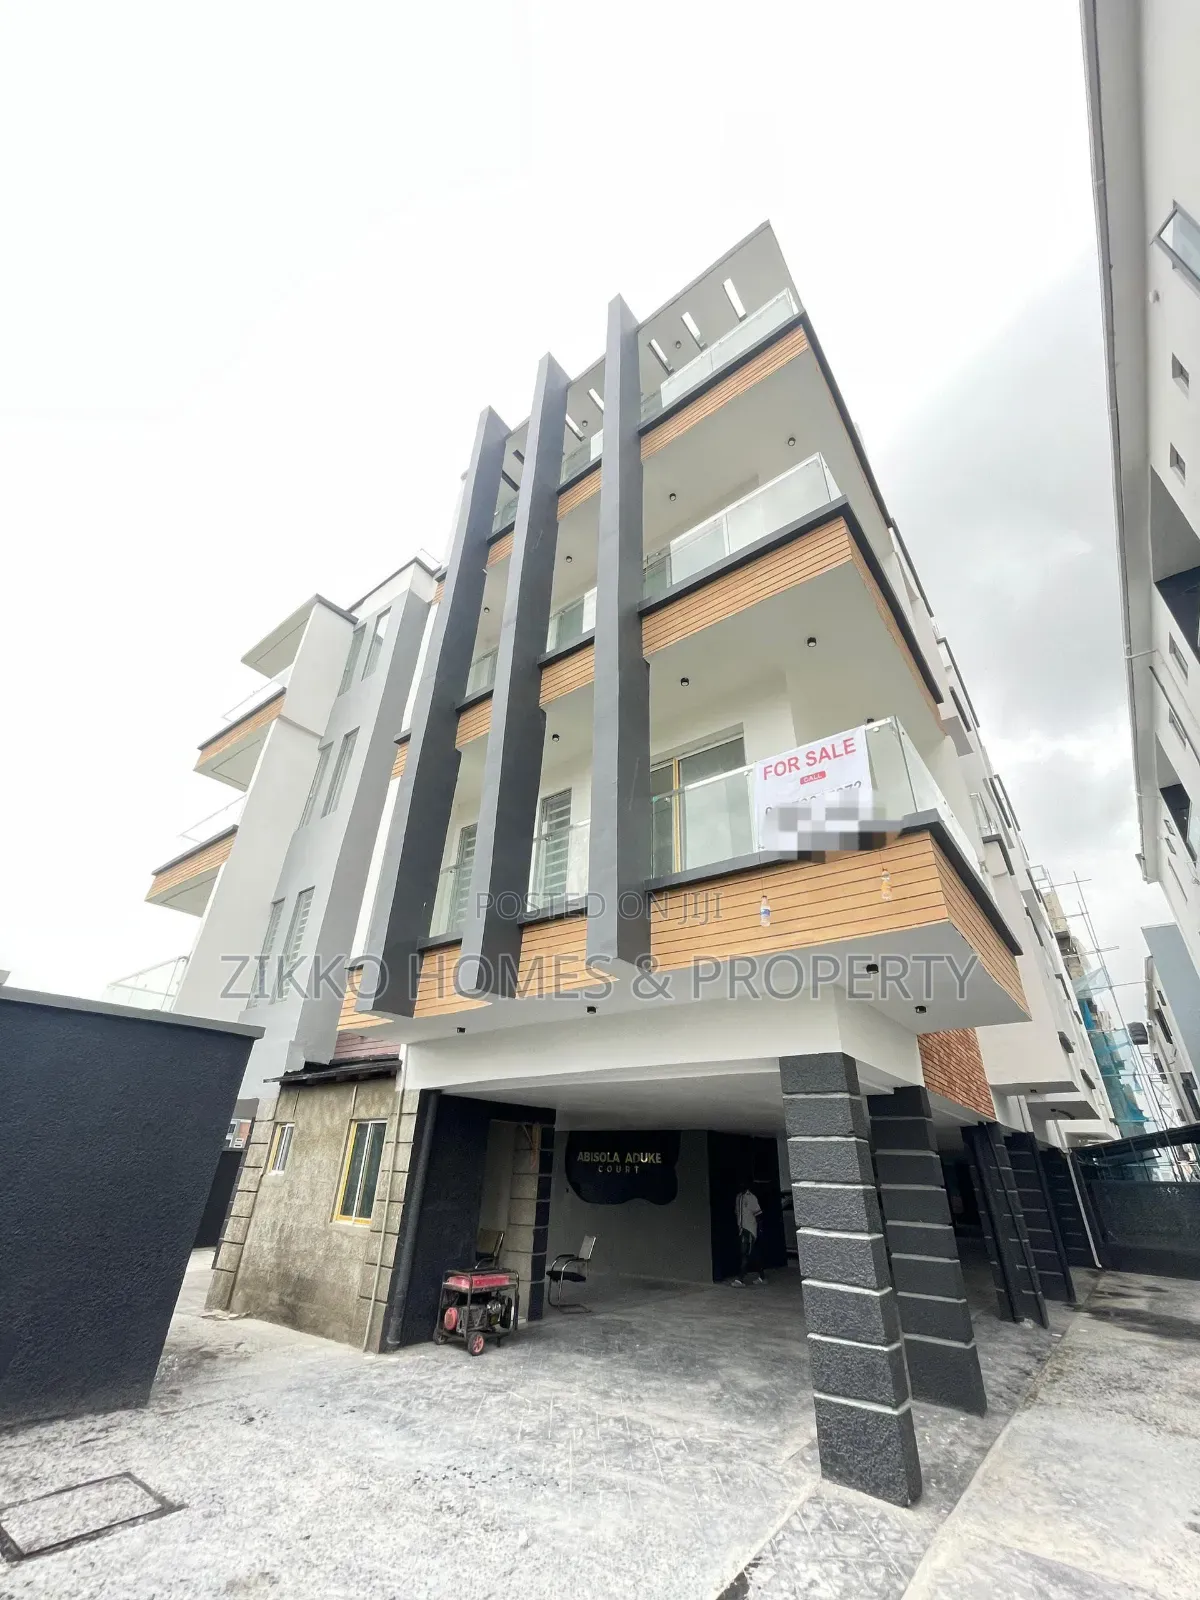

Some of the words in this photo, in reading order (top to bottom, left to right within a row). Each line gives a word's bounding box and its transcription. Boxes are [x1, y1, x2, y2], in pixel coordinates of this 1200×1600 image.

[763, 756, 800, 781] FOR
[805, 737, 857, 767] SALE
[803, 773, 823, 783] CALL
[577, 1151, 620, 1163] ABISOLA
[625, 1152, 662, 1164] ADUKE
[598, 1165, 640, 1174] COURT
